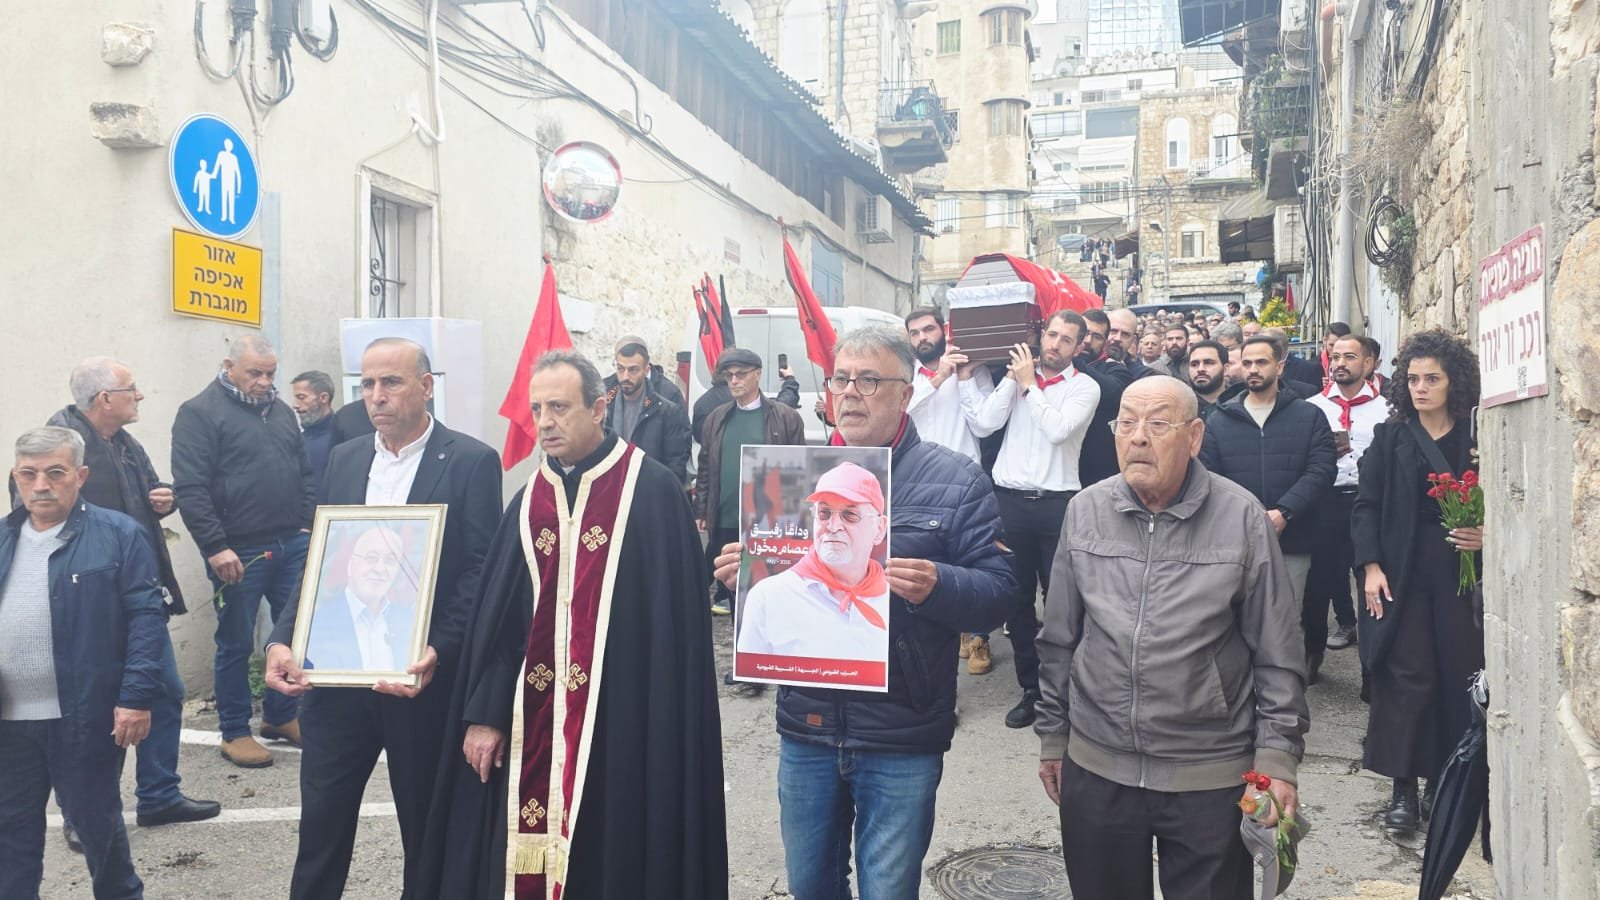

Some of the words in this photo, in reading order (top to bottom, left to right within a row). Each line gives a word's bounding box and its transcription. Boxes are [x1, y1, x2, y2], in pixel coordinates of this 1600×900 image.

[203, 244, 236, 265] אזור
[1511, 236, 1541, 282] חניה
[193, 266, 244, 290] אכיפה
[1481, 255, 1510, 300] פרטית
[189, 290, 248, 314] מוגברת
[1504, 321, 1514, 365] זר
[1519, 311, 1541, 359] רכב
[750, 523, 782, 538] رفيق
[778, 543, 809, 555] عصام
